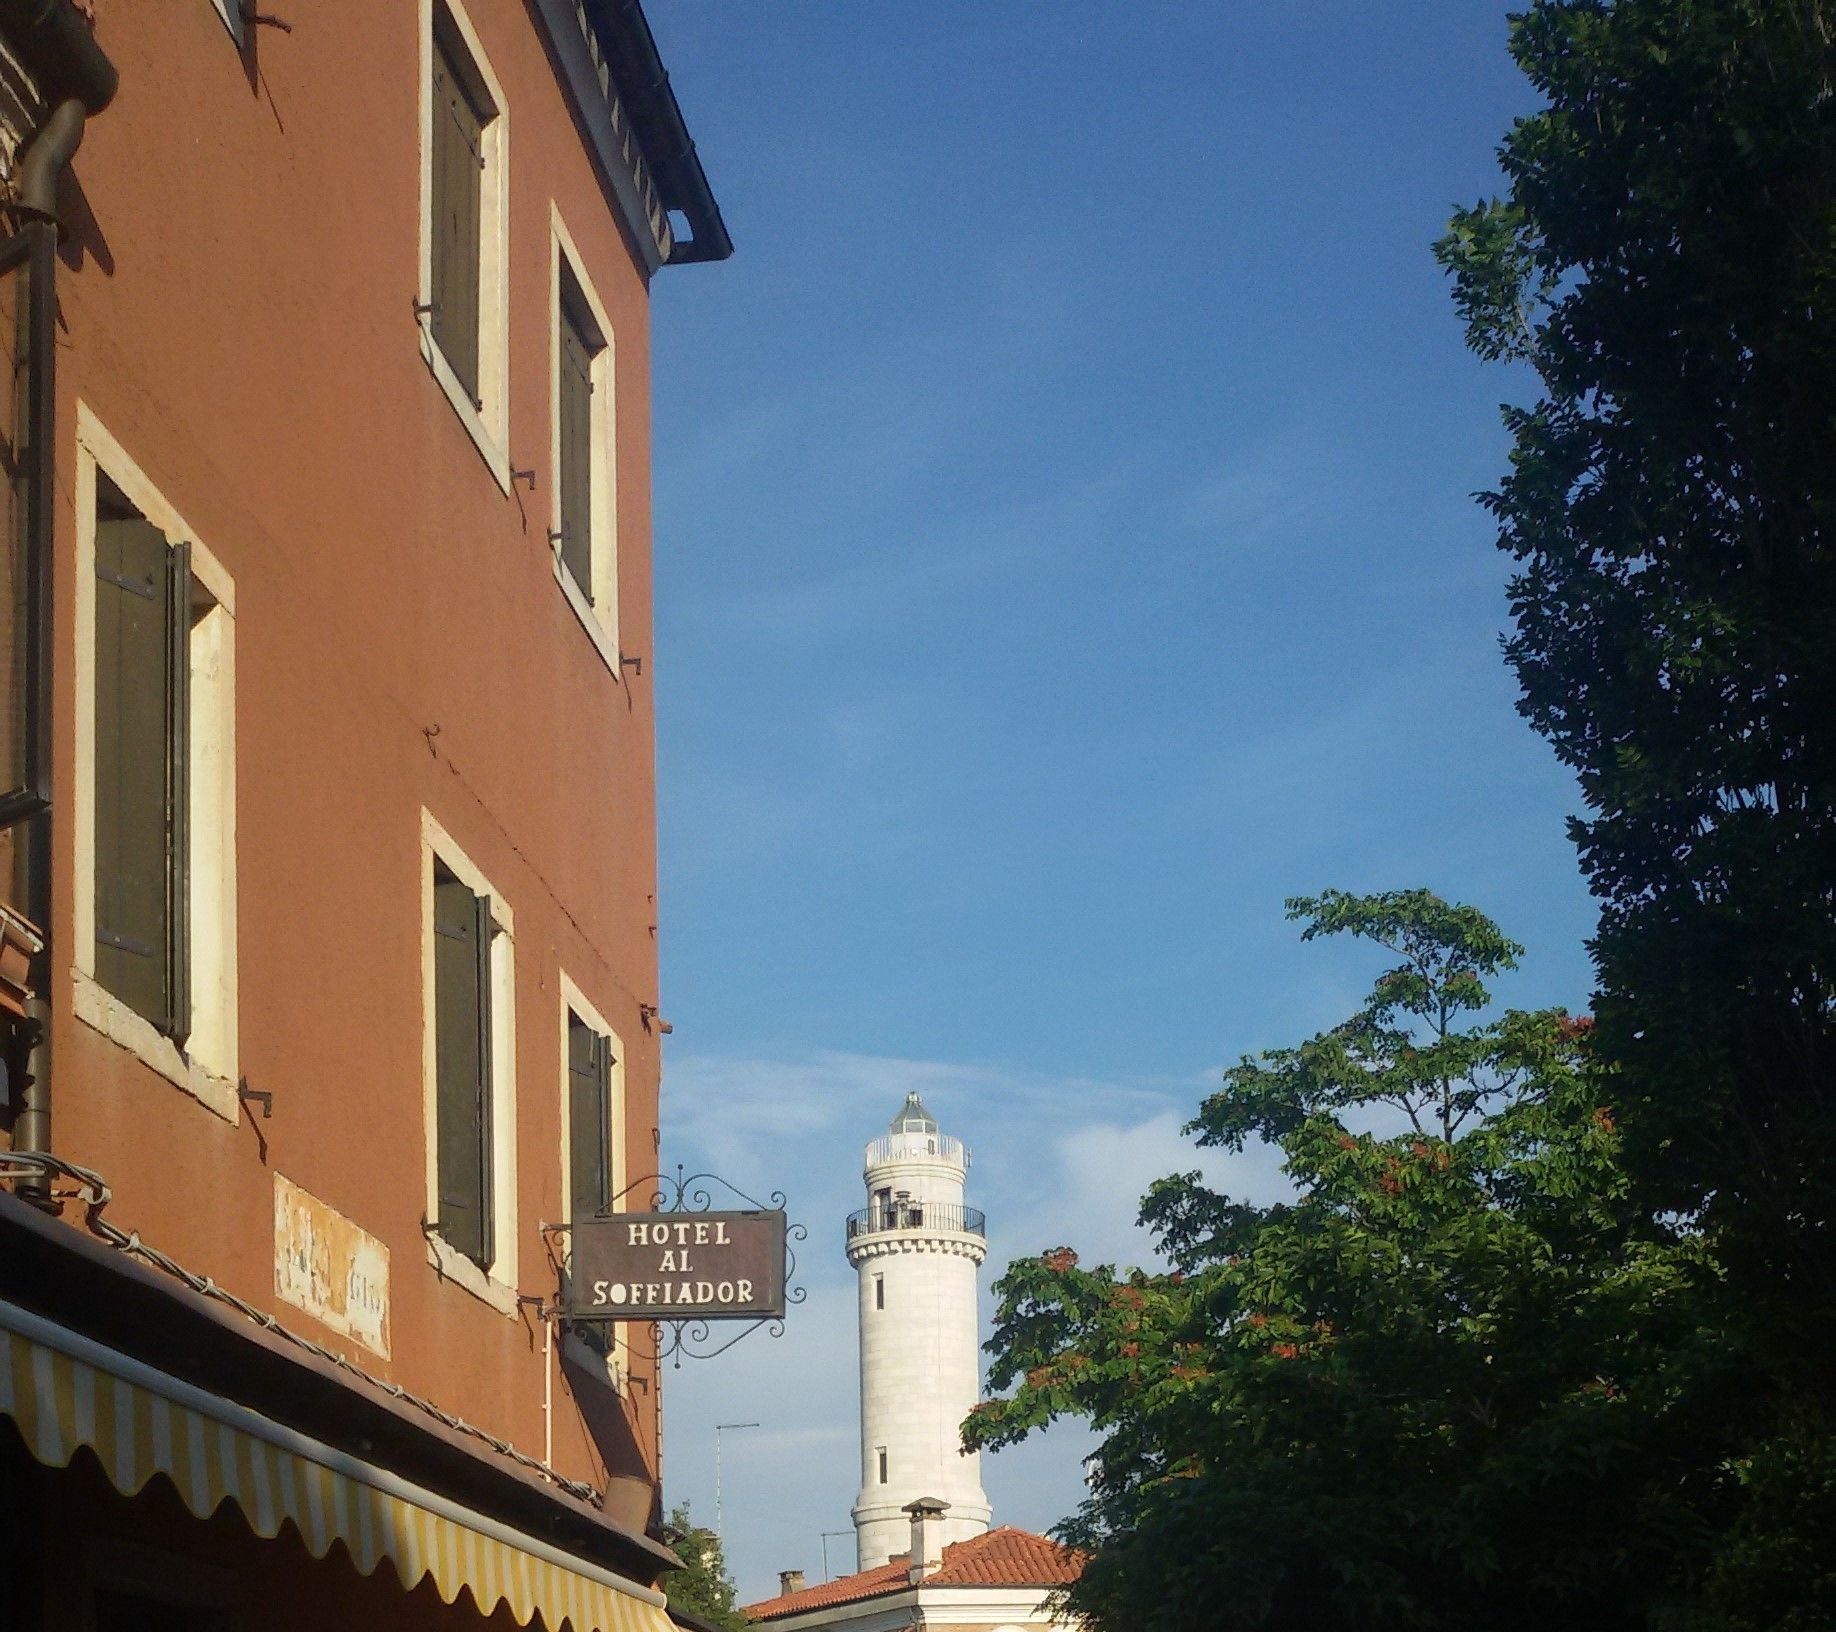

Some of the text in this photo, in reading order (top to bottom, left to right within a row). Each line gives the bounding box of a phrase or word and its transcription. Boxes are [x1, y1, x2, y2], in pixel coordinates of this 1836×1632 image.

[628, 1221, 731, 1246] HOTEL
[658, 1248, 694, 1272] AL
[592, 1278, 754, 1306] SOFFIADOR
